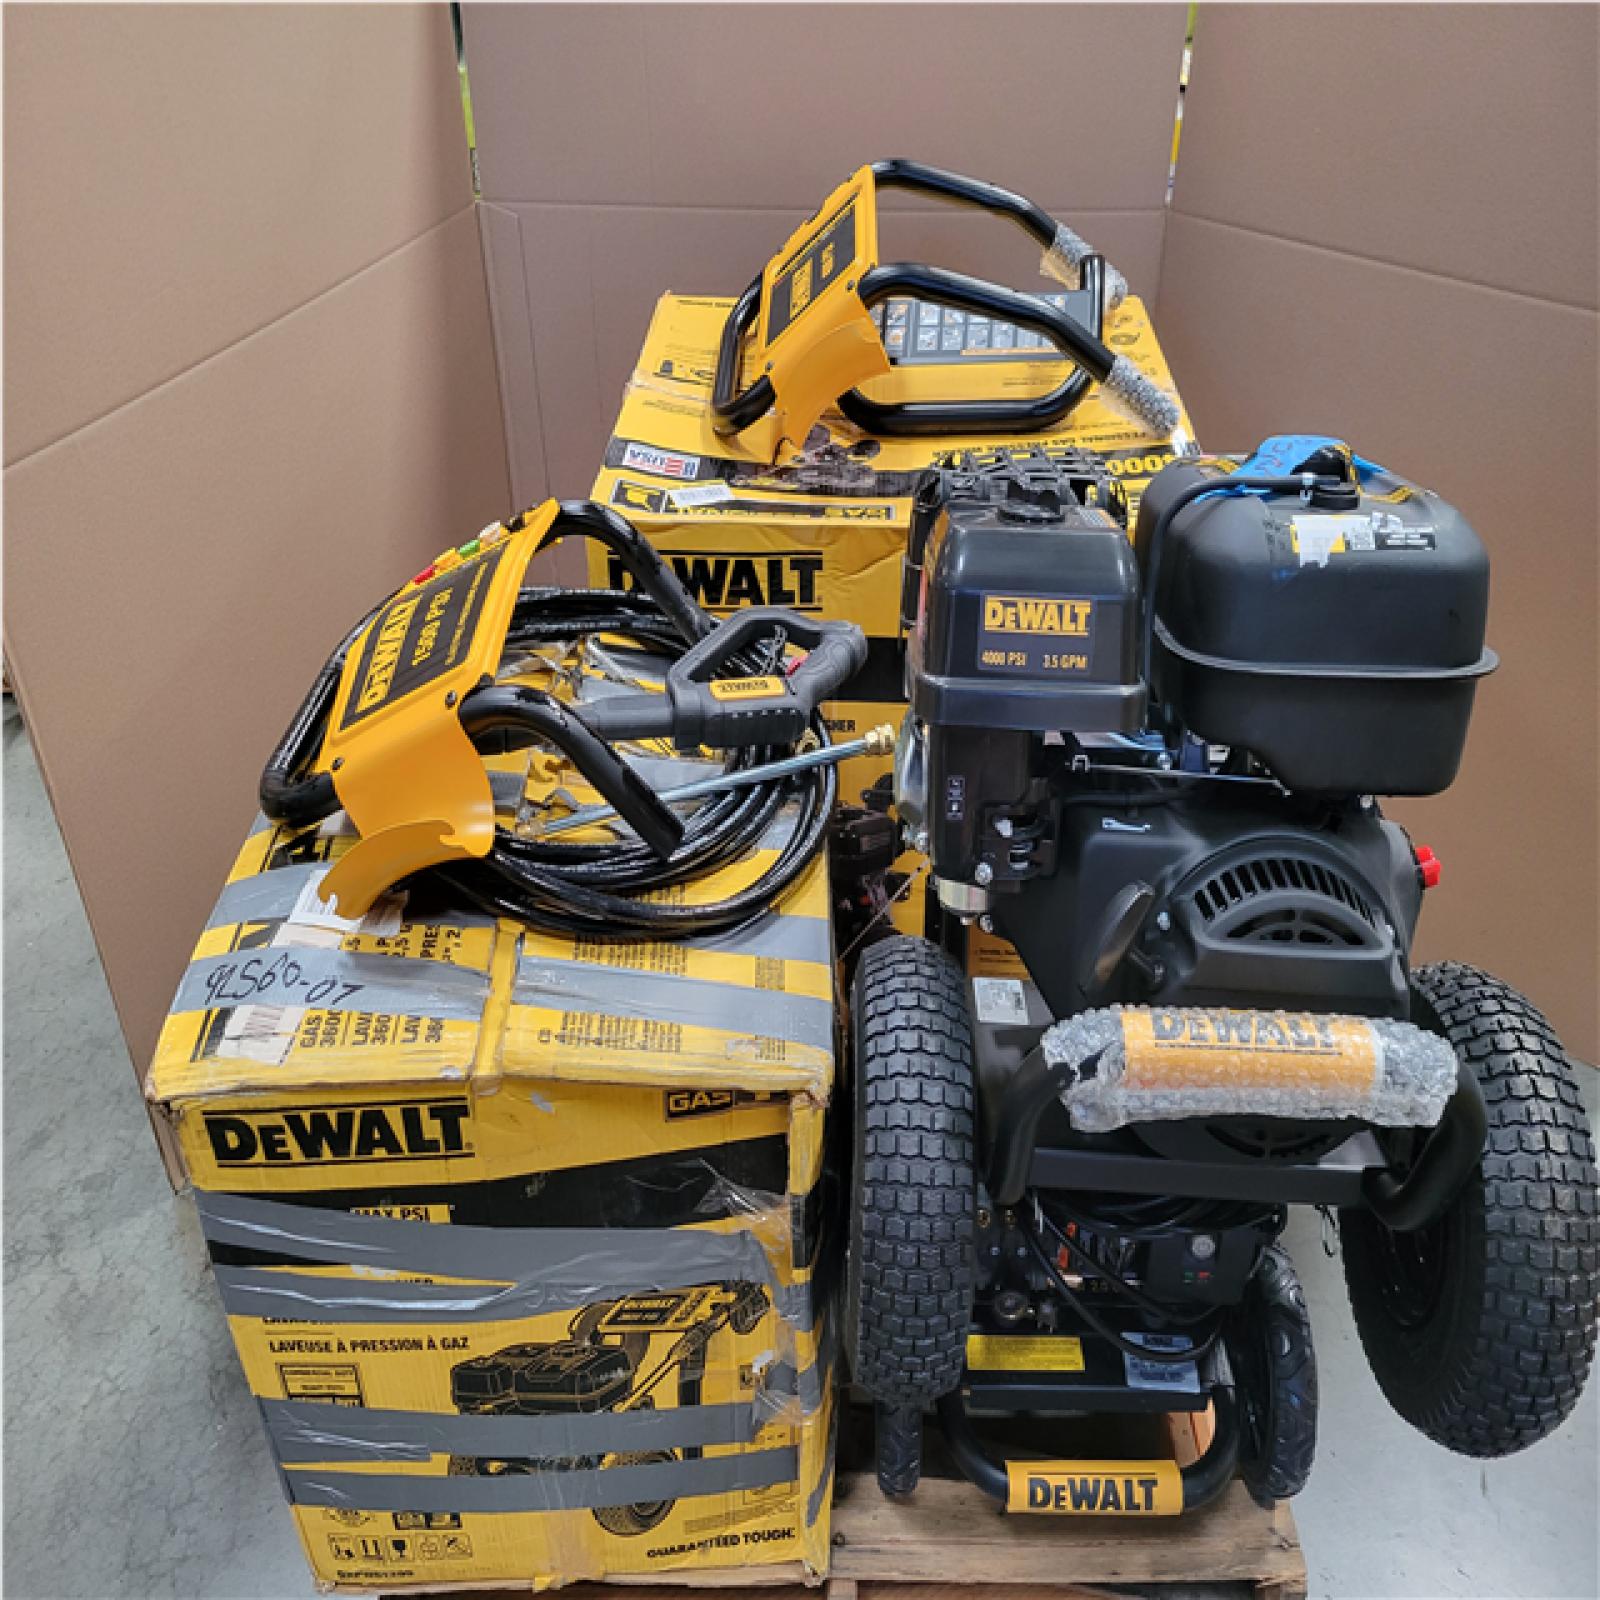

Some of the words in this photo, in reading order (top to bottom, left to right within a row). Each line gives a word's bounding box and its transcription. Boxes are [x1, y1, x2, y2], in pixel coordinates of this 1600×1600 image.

[984, 599, 1092, 632] DEWALT
[1007, 651, 1027, 667] PSI
[1060, 654, 1088, 670] GPM
[300, 1015, 323, 1048] GAS
[204, 1104, 471, 1161] DEWALT
[400, 1206, 429, 1221] PSI
[269, 1339, 332, 1353] LAVEUSE
[350, 1338, 423, 1353] PRESSION
[440, 1336, 470, 1351] GAZ
[1028, 1477, 1159, 1511] DEWALT
[646, 1534, 741, 1558] GUARANTEED
